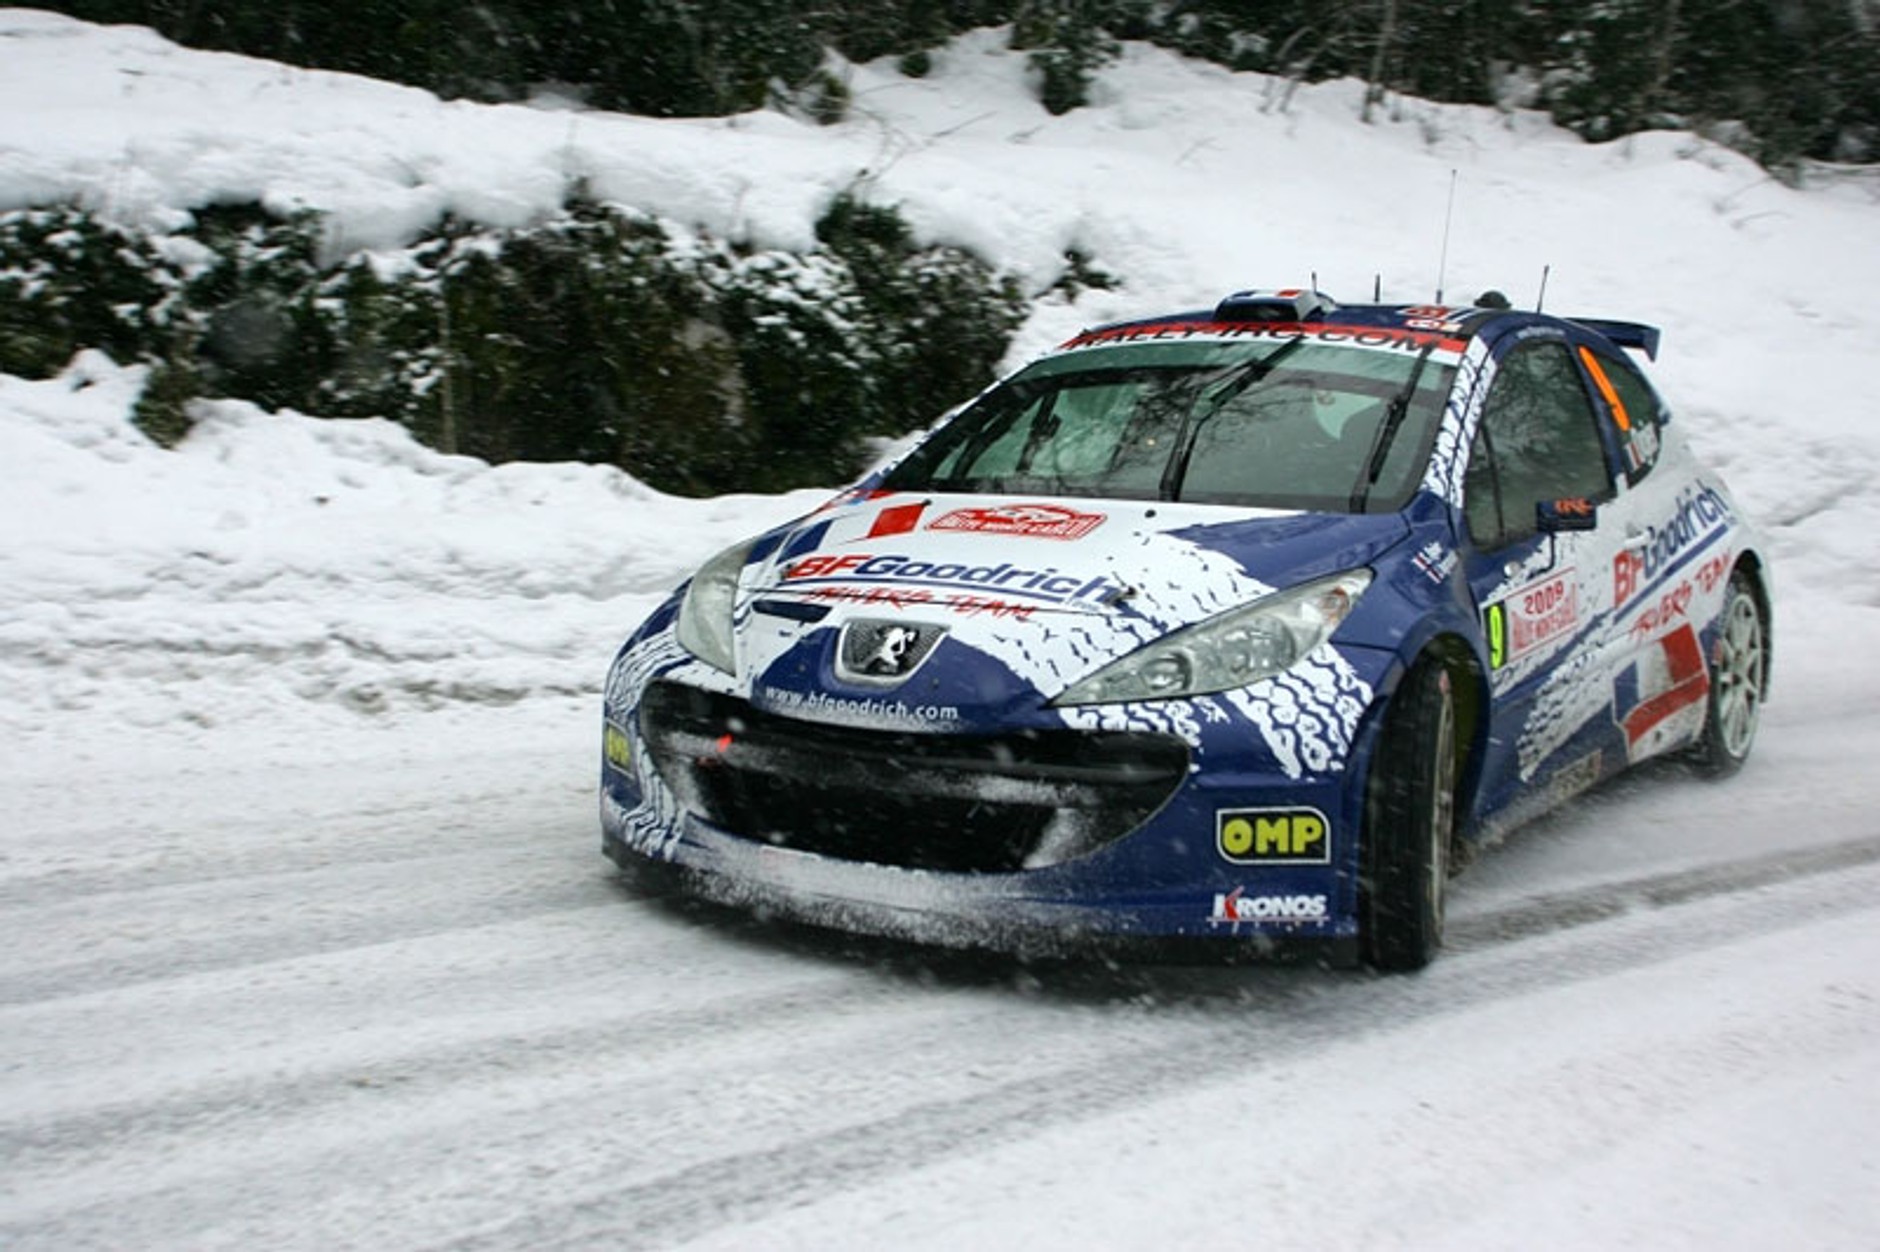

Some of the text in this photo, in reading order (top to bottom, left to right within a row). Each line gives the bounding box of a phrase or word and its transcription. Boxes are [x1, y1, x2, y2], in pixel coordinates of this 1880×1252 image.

[785, 555, 1121, 604] BFGoodrich
[1524, 580, 1564, 615] 2009
[1489, 605, 1504, 669] 9
[765, 686, 958, 721] www.bfgoodrich.com
[1223, 816, 1322, 854] OMP
[1212, 885, 1327, 921] KRONOS
